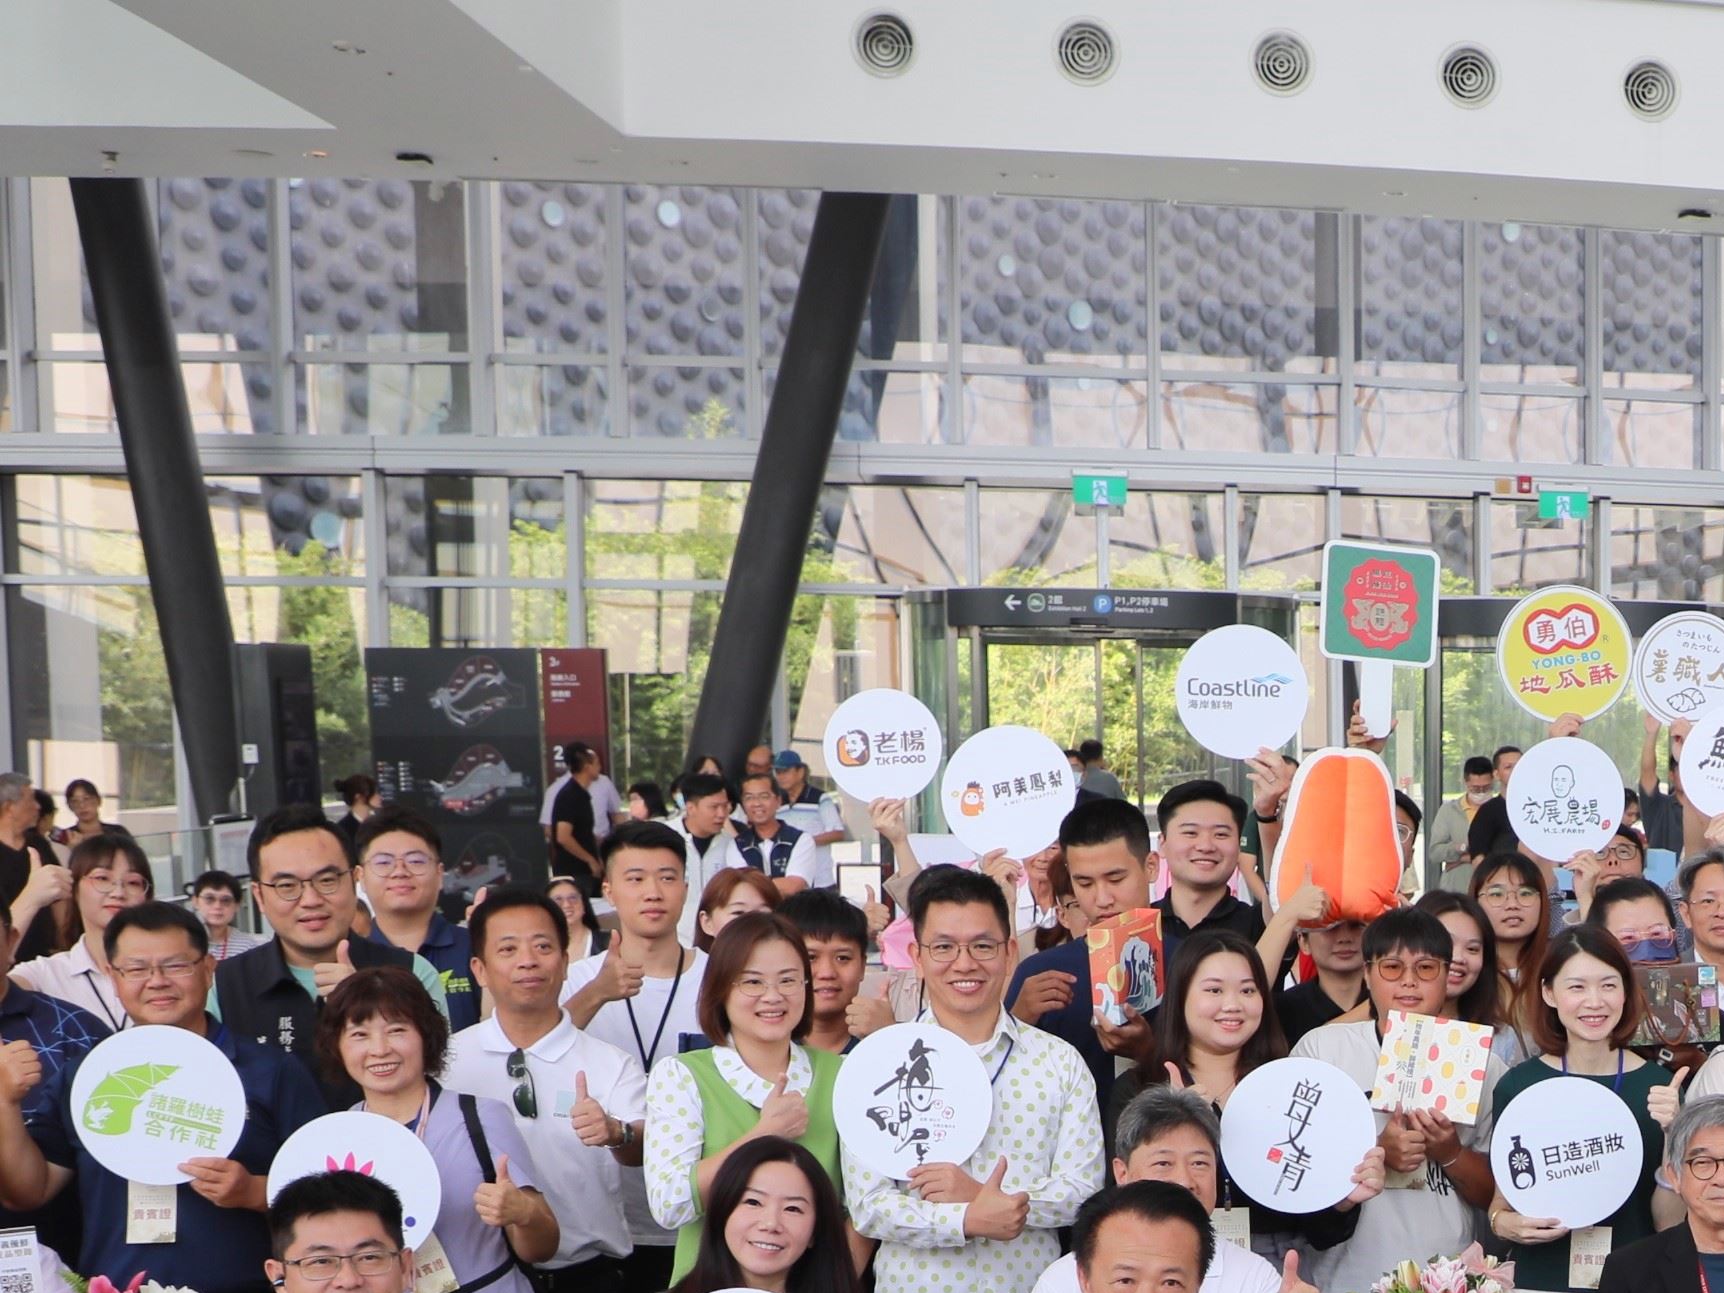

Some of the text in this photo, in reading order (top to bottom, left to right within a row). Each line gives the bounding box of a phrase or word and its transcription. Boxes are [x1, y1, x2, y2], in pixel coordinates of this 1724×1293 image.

[1536, 615, 1588, 643] 勇伯
[1532, 650, 1601, 670] YONG-BO
[1187, 678, 1281, 698] Coastline
[1519, 664, 1619, 695] 地瓜酥
[1187, 699, 1233, 710] 海岸鮮物
[873, 730, 926, 753] 老楊
[892, 754, 926, 765] FOOD
[992, 769, 1064, 799] 阿美鳳梨
[1522, 796, 1602, 826] 宏展農場
[148, 1094, 225, 1126] 諸羅樹蛙
[144, 1119, 218, 1151] 合作社
[1541, 1132, 1625, 1167] 日造酒妝
[1546, 1160, 1601, 1182] SunWell
[133, 1208, 172, 1221] 貴賓證
[1573, 1253, 1605, 1267] 貴賓證
